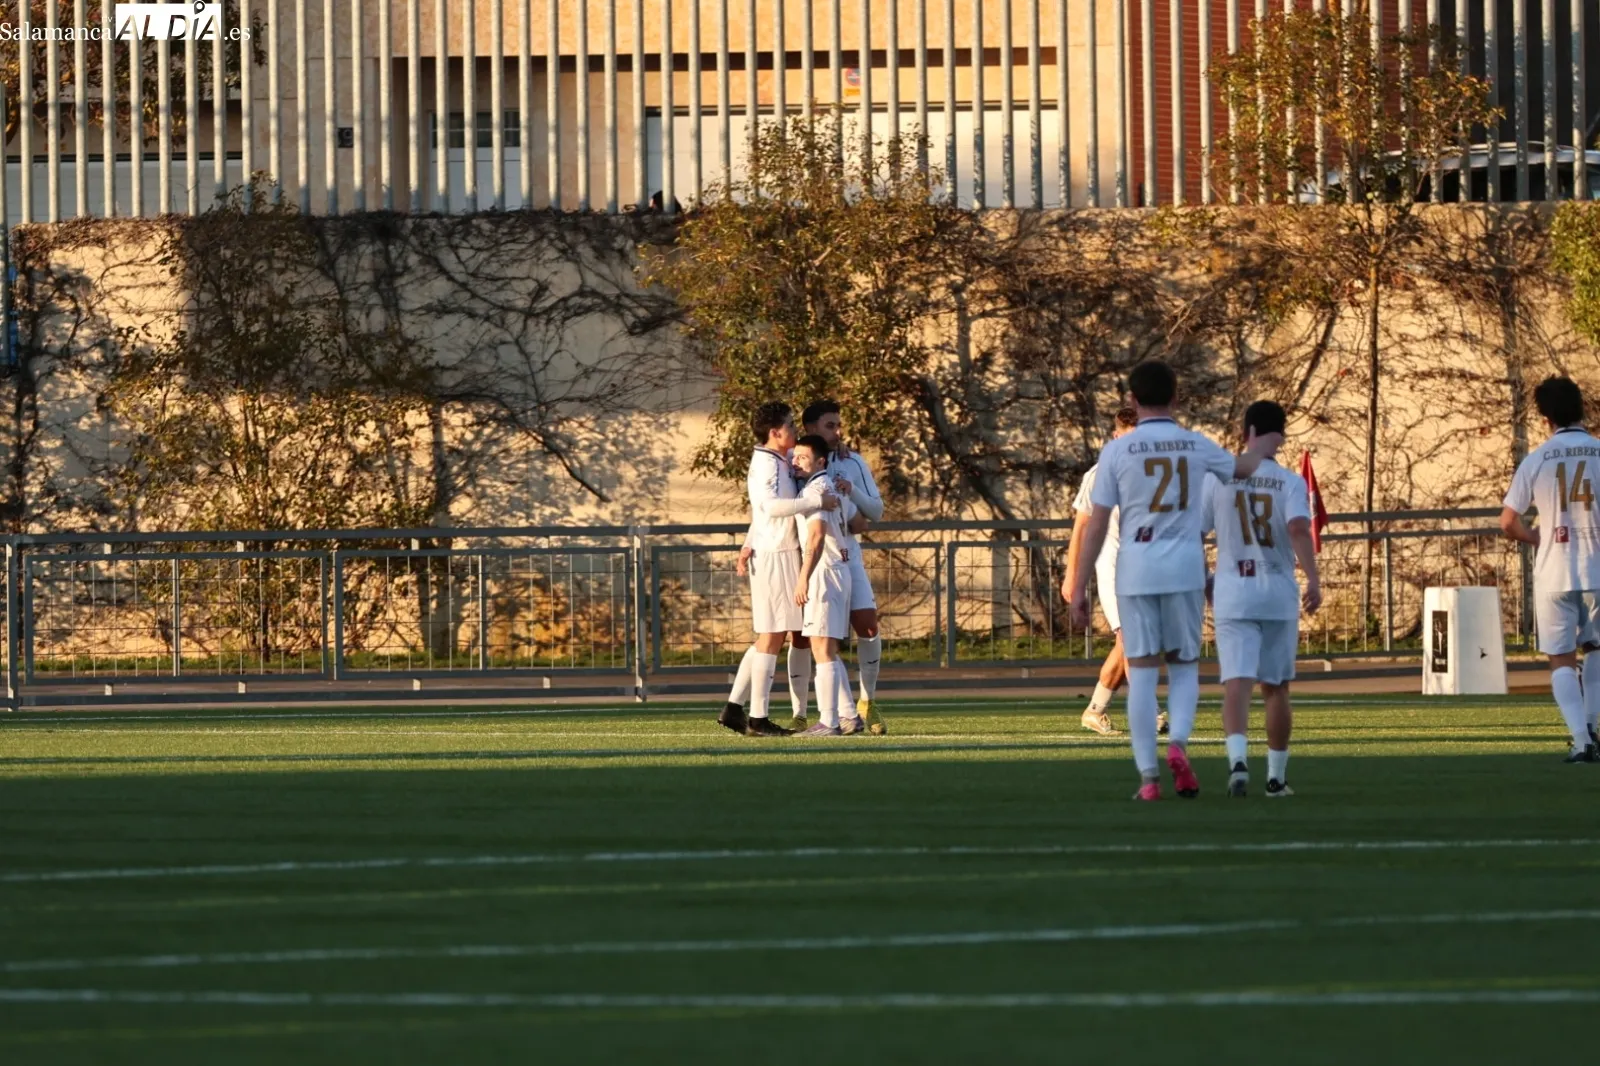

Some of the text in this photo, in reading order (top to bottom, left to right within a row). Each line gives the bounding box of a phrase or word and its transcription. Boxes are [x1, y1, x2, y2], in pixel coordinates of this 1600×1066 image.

[1153, 438, 1196, 453] RIBERT
[1144, 456, 1190, 513] 21
[1555, 460, 1595, 513] 14
[1234, 490, 1274, 549] 18
